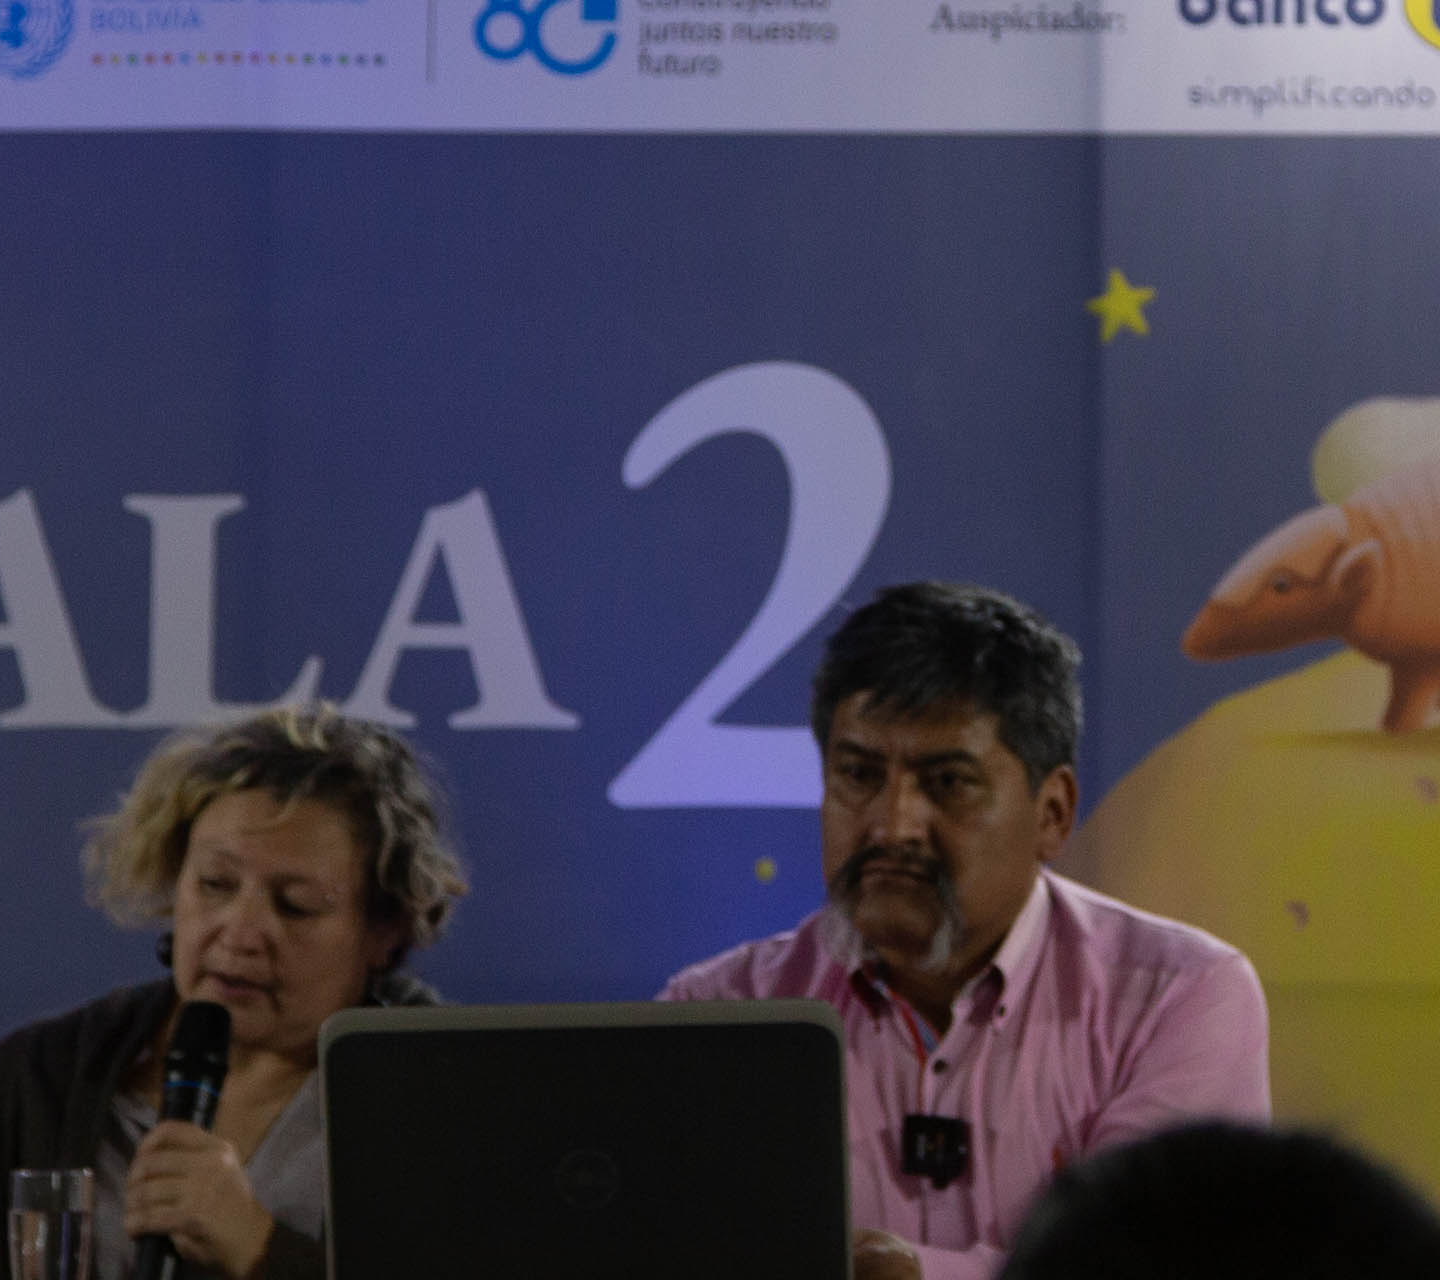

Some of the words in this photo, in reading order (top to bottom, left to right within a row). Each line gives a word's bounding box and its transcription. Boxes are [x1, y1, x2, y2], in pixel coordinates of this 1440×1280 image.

[90, 7, 202, 32] BOLIVIA
[634, 17, 723, 49] juntos
[731, 19, 838, 44] nuestro
[636, 48, 721, 77] futuro
[1187, 74, 1437, 116] simplificando
[606, 360, 892, 808] 2
